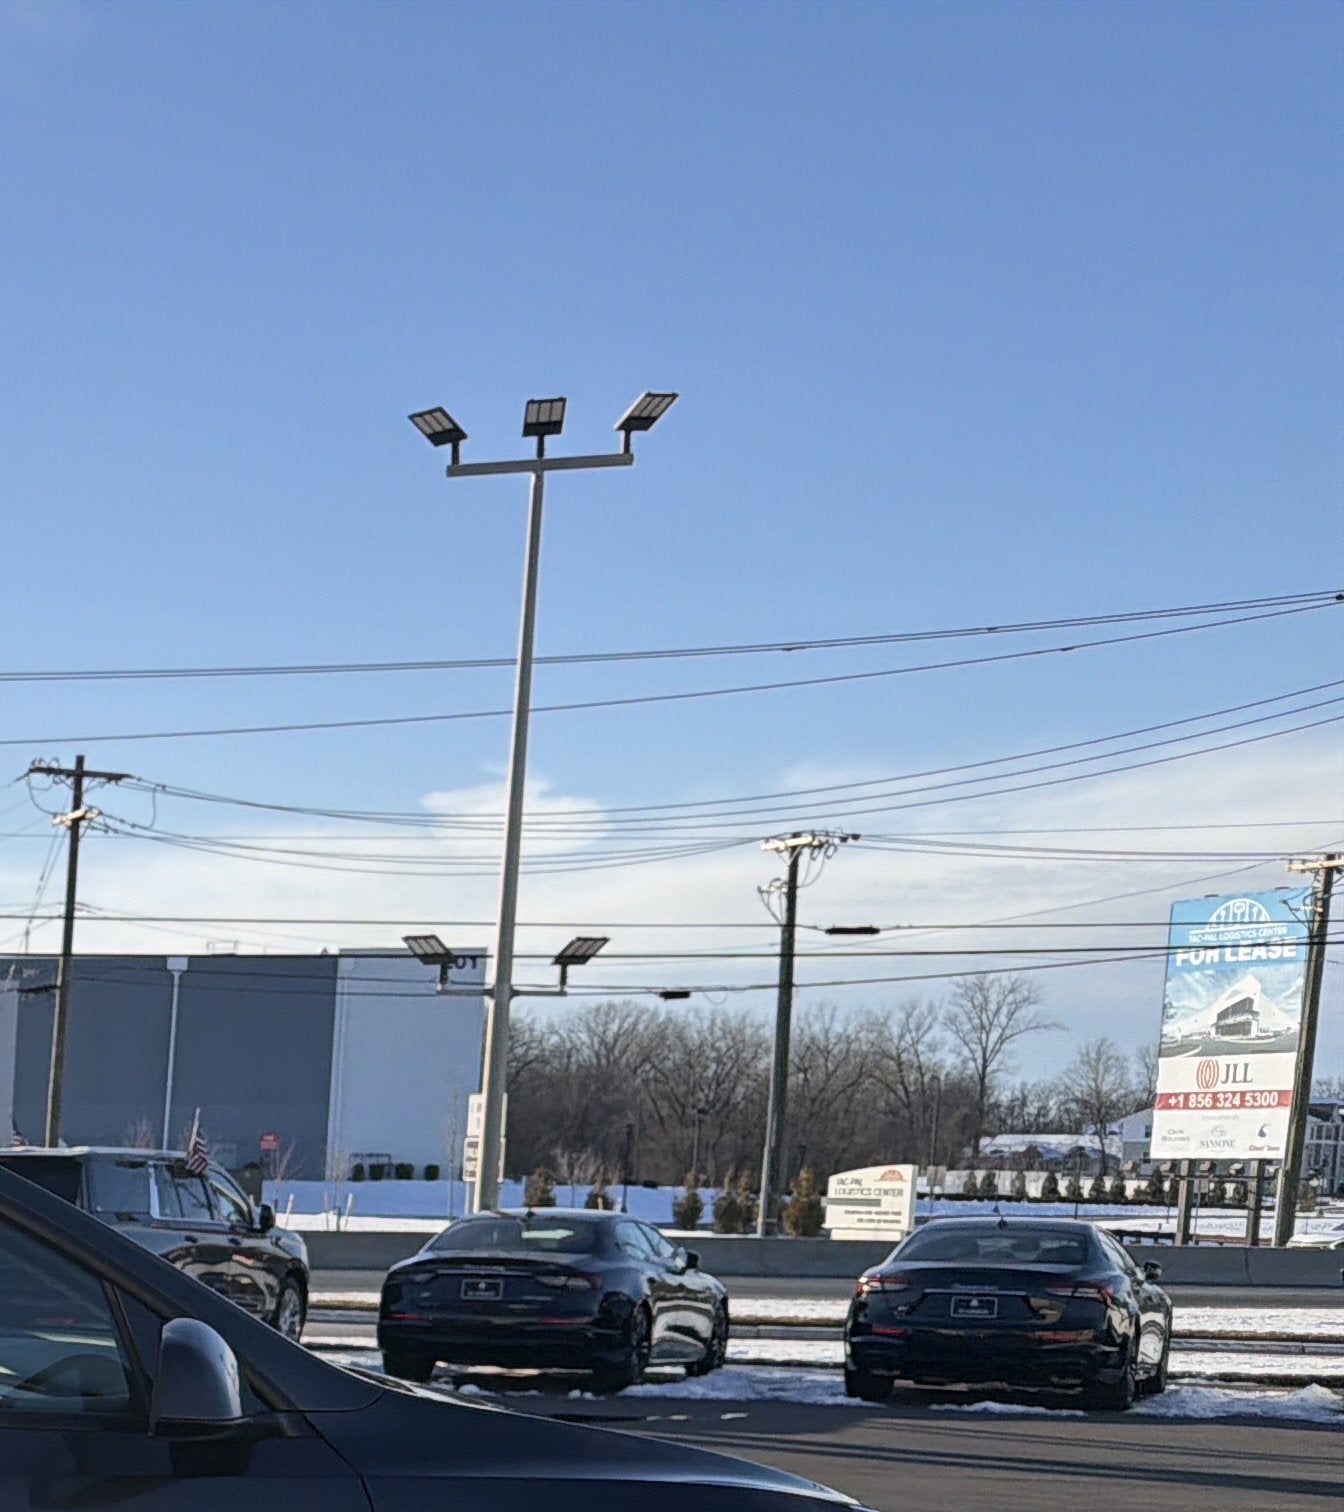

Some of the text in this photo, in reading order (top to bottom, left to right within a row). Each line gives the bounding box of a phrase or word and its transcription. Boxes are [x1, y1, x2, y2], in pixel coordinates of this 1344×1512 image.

[1219, 929, 1258, 940] LOGISTICS
[1258, 925, 1288, 937] CENTER
[1175, 936, 1297, 967] FOR LEASE
[1221, 1062, 1254, 1084] JLL
[1168, 1091, 1279, 1108] +1 856 324 5300
